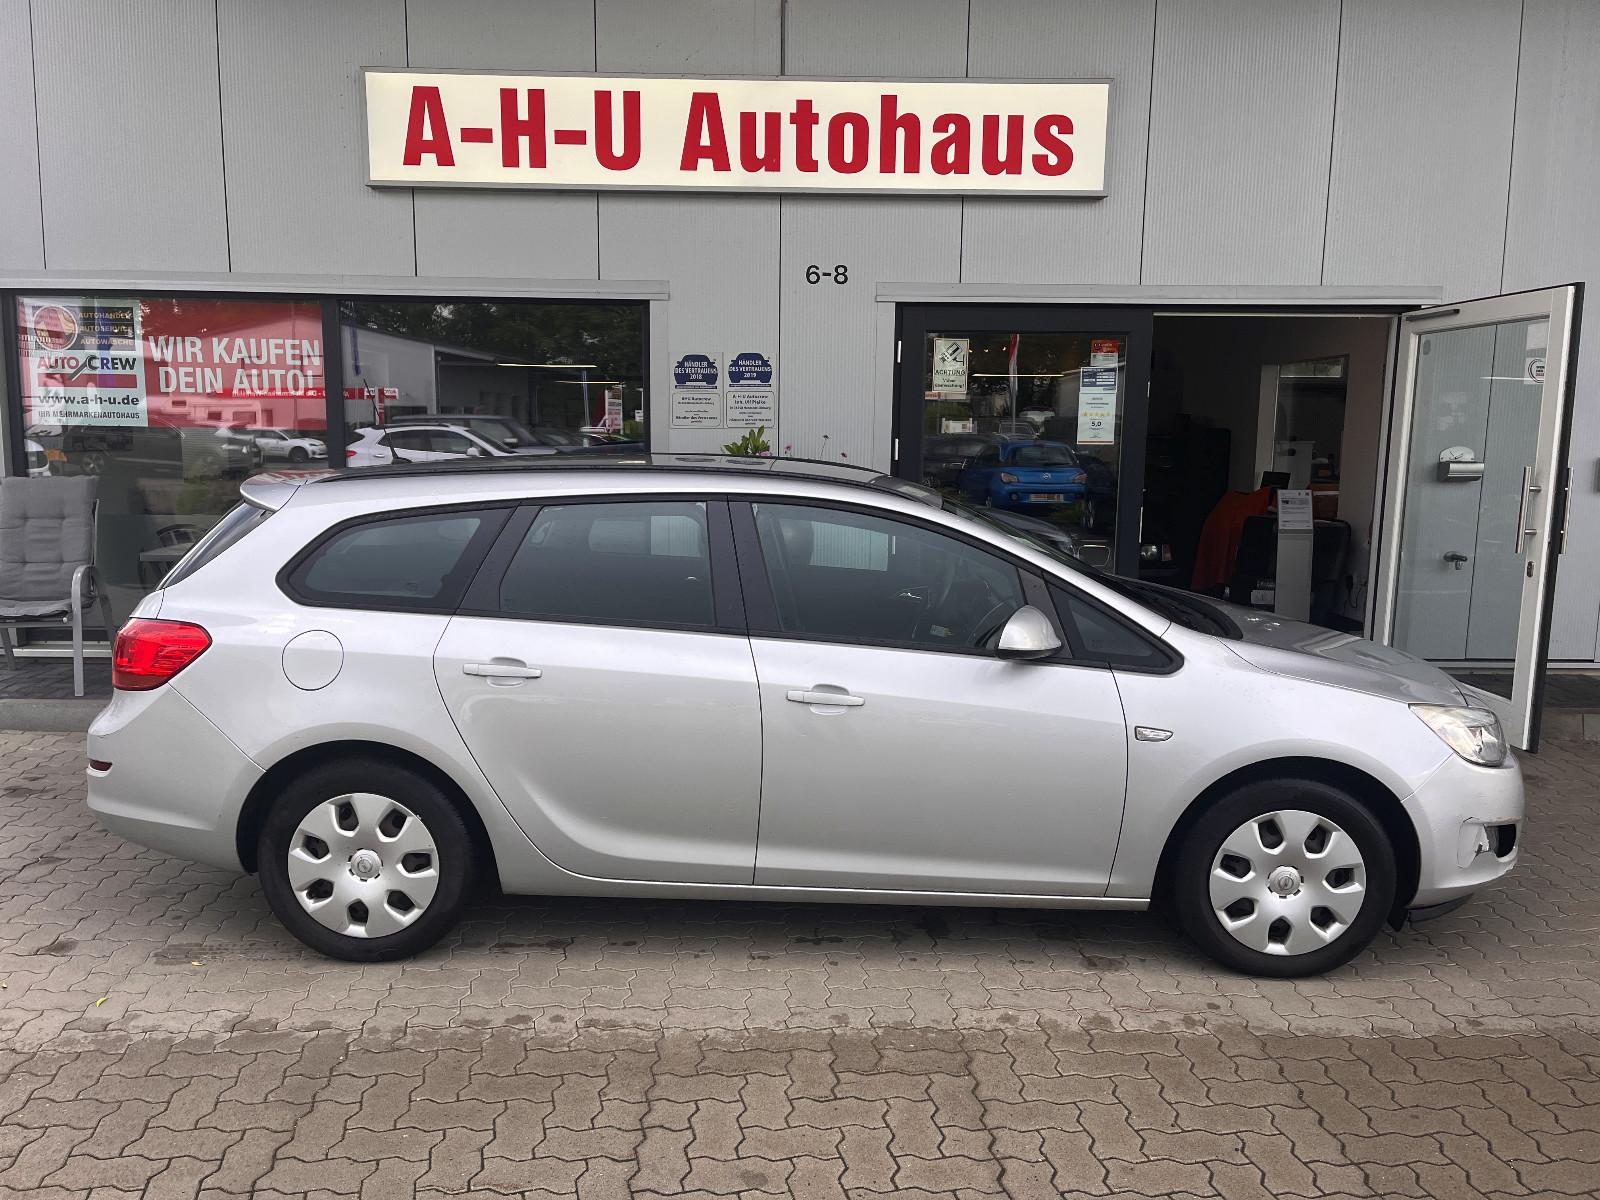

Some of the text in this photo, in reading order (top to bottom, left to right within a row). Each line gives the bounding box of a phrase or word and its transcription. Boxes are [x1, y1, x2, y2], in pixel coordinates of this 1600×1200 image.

[402, 85, 1074, 177] A-H-U Autohaus
[805, 264, 849, 286] 6-8
[148, 335, 321, 366] WIR KAUFEN
[37, 354, 136, 371] AUTO CREW
[158, 367, 314, 395] DEIN AUTO!
[38, 394, 140, 406] www.a-h-u.de
[1091, 420, 1102, 428] 5,0
